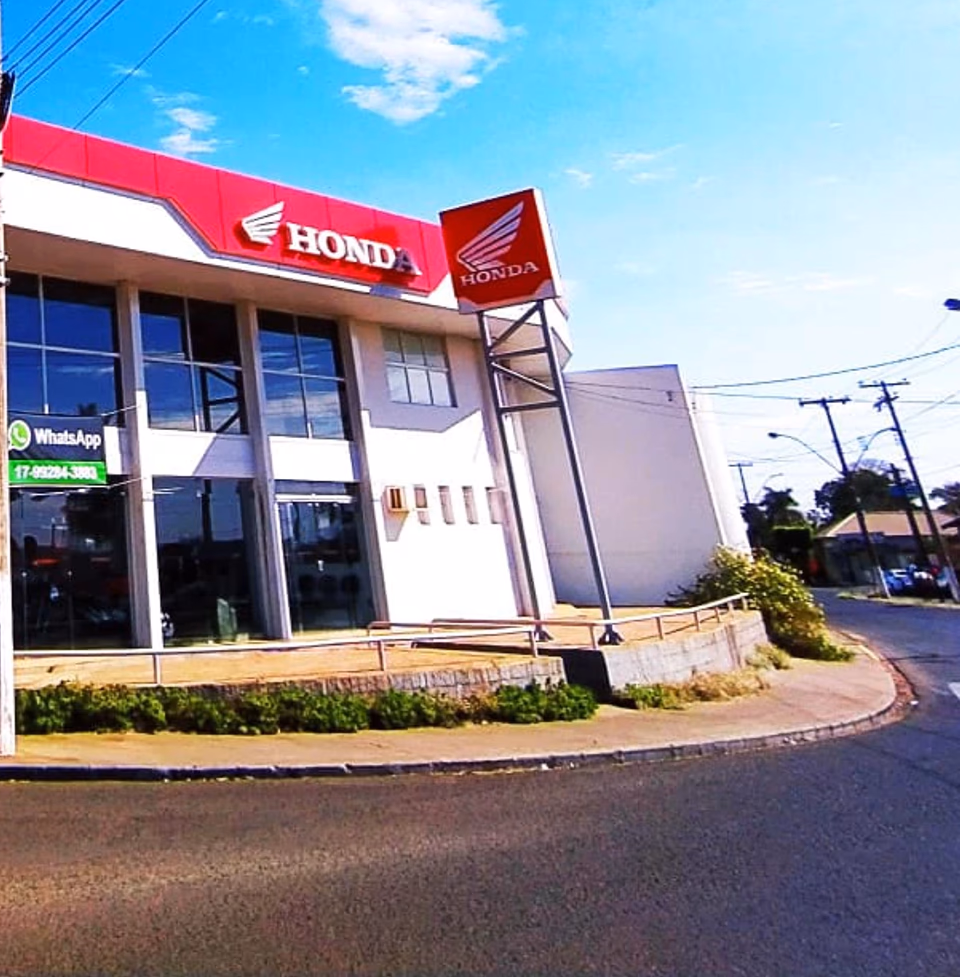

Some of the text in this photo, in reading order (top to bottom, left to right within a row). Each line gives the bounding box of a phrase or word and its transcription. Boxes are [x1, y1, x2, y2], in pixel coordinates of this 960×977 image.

[286, 221, 422, 276] HONDA
[460, 261, 539, 287] HONDA
[34, 428, 102, 450] WhatsApp
